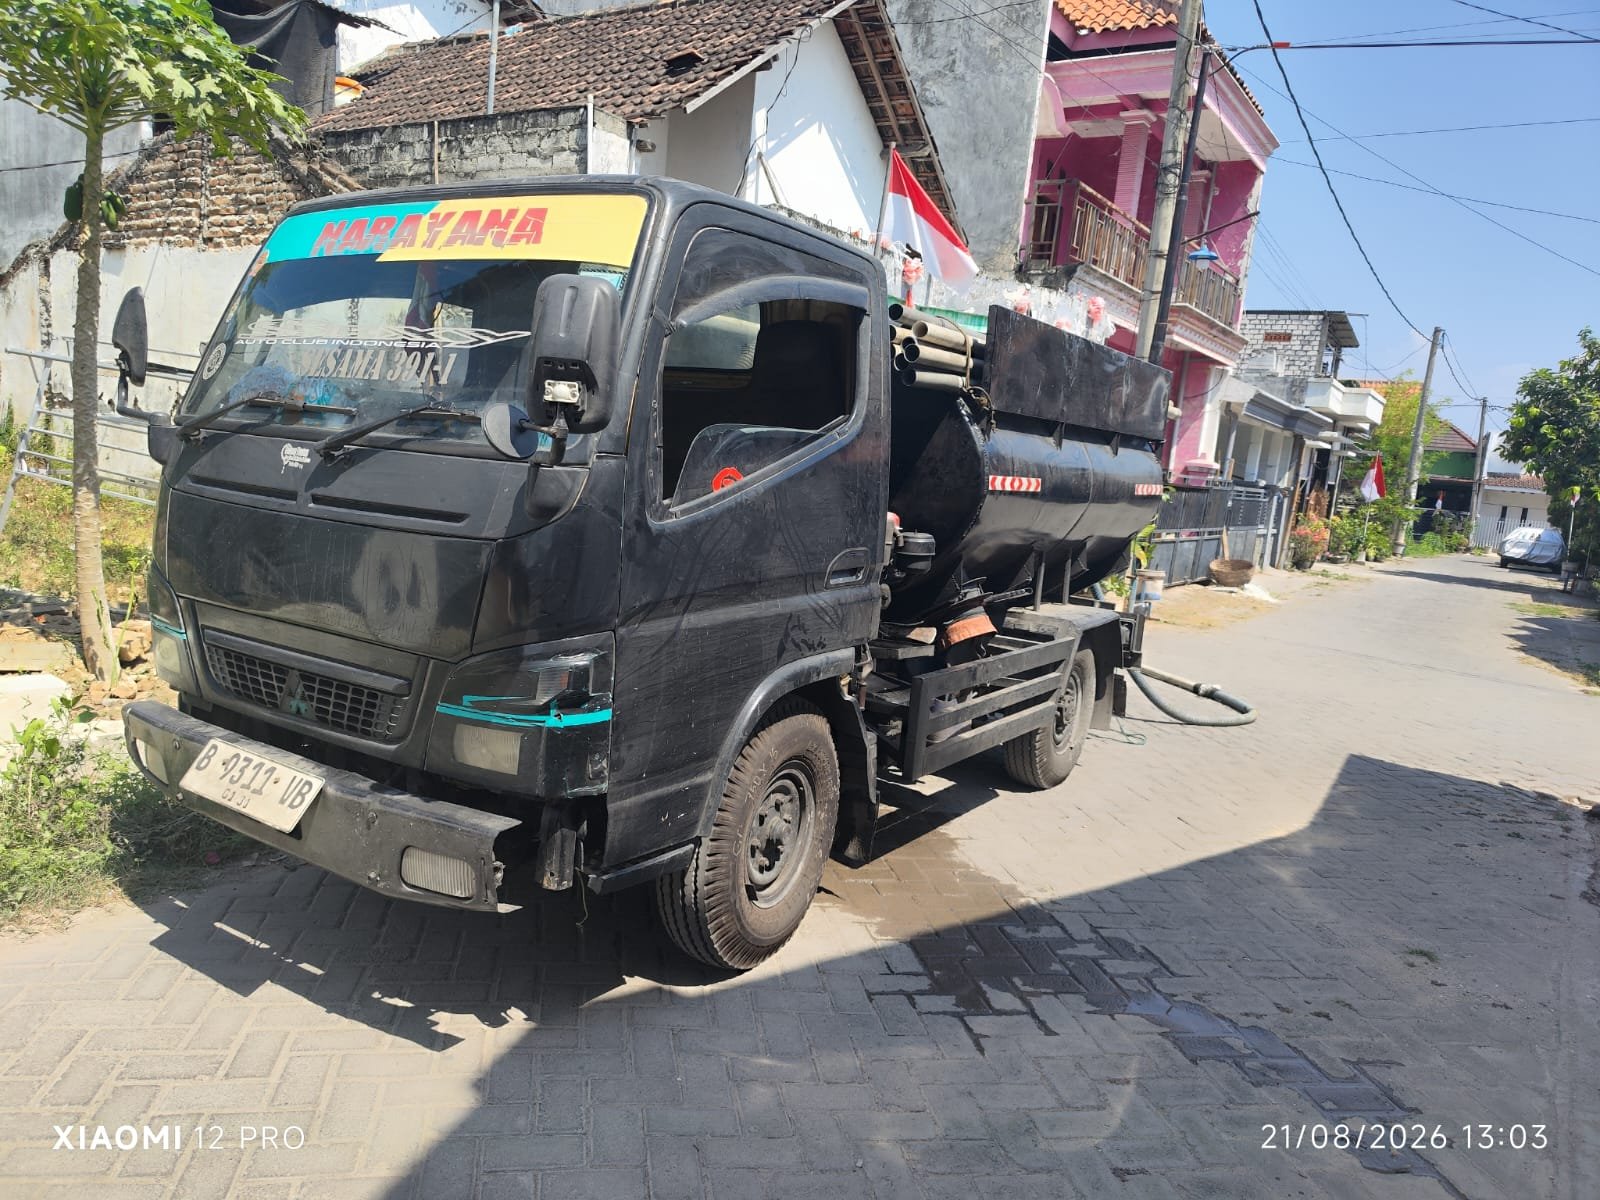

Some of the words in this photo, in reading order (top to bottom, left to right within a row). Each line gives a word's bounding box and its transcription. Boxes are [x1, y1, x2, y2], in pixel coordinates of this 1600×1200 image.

[310, 207, 549, 257] NARAYANA
[234, 338, 278, 346] AUTO
[281, 338, 327, 346] CLUB
[331, 338, 442, 349] INDONESIA
[195, 743, 218, 772] B
[220, 752, 277, 796] 9311
[278, 775, 313, 810] VB
